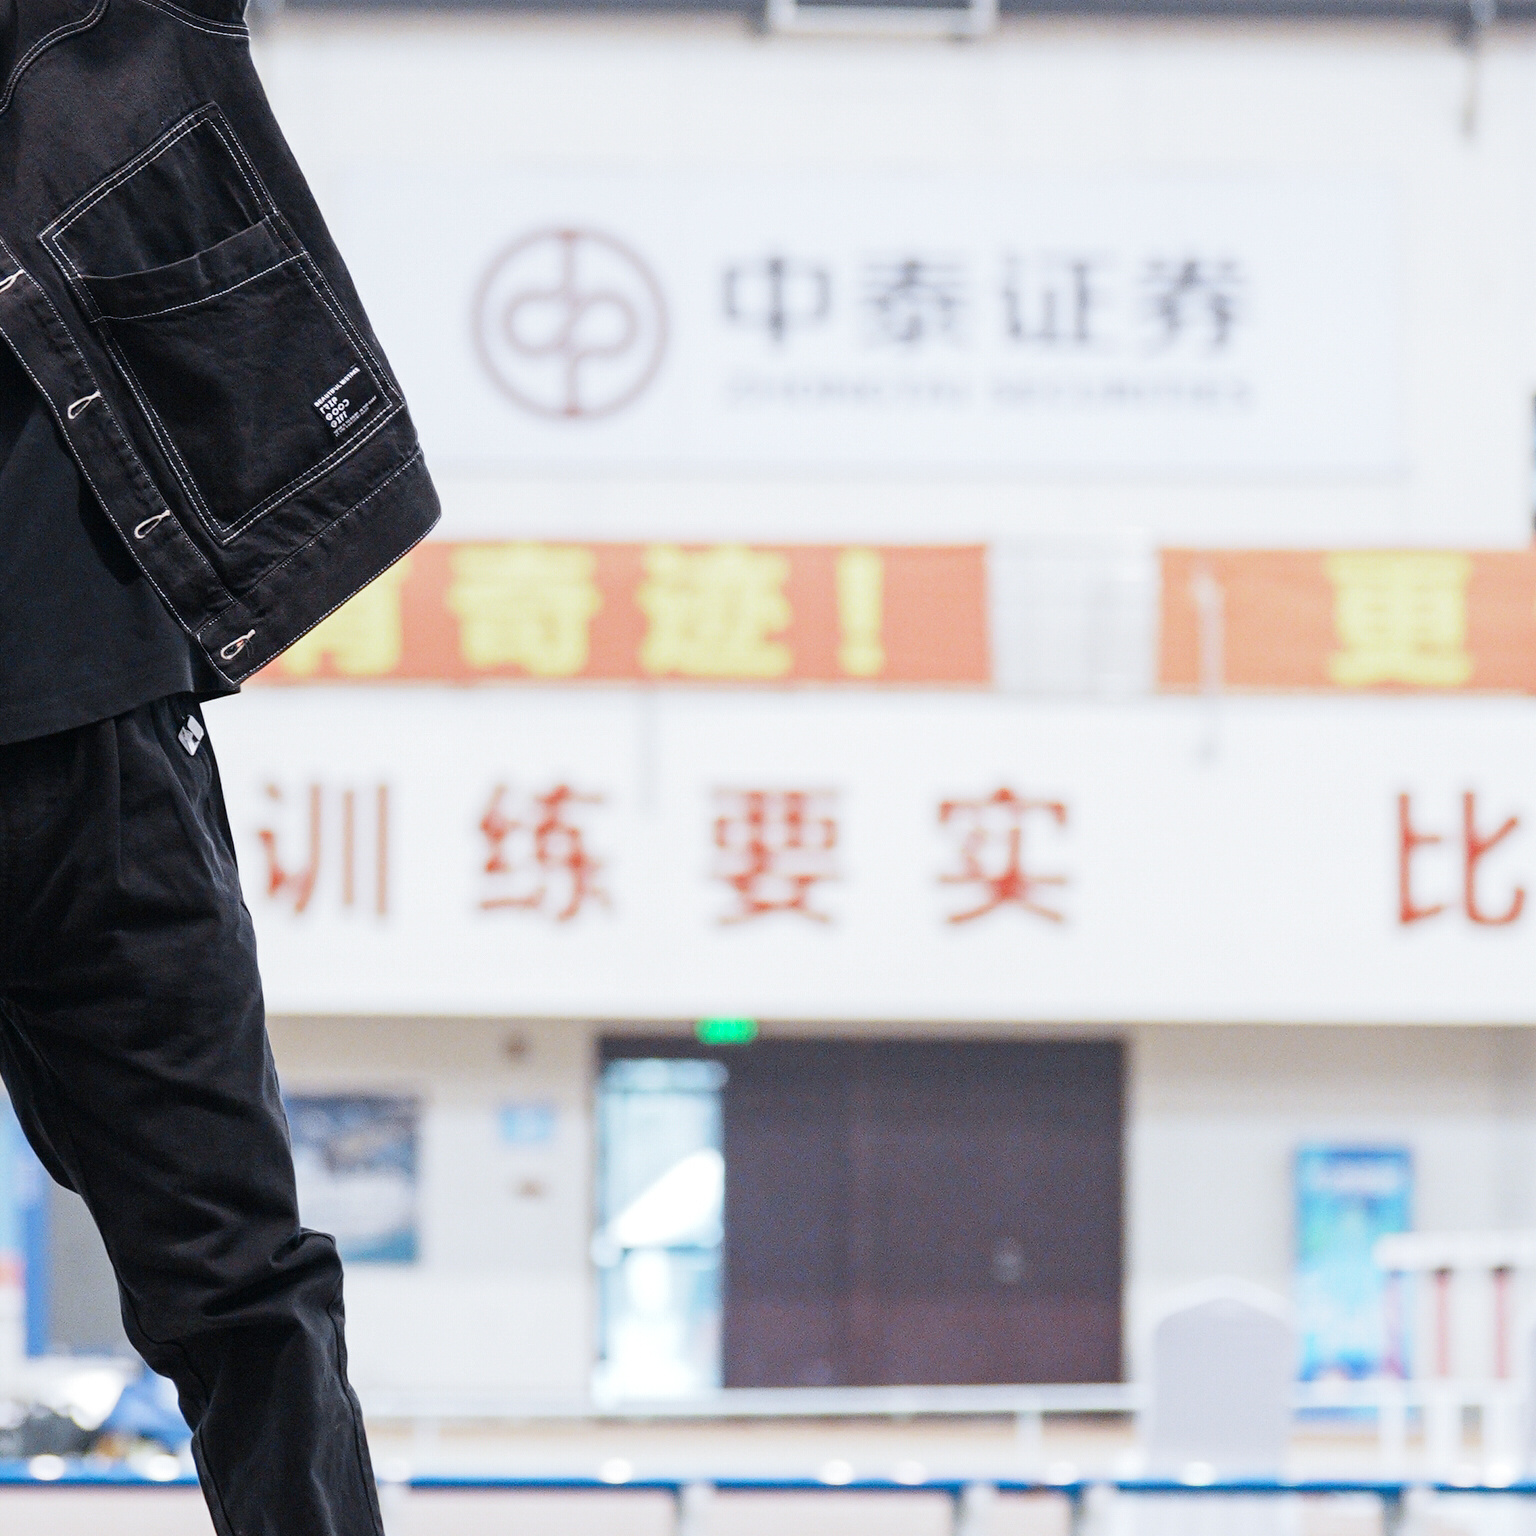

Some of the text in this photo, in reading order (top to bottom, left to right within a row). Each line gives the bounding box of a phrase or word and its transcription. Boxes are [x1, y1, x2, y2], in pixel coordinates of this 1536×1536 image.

[720, 250, 1249, 352] 中泰证券
[259, 780, 1071, 926] 训练要实
[1396, 790, 1526, 927] 比
